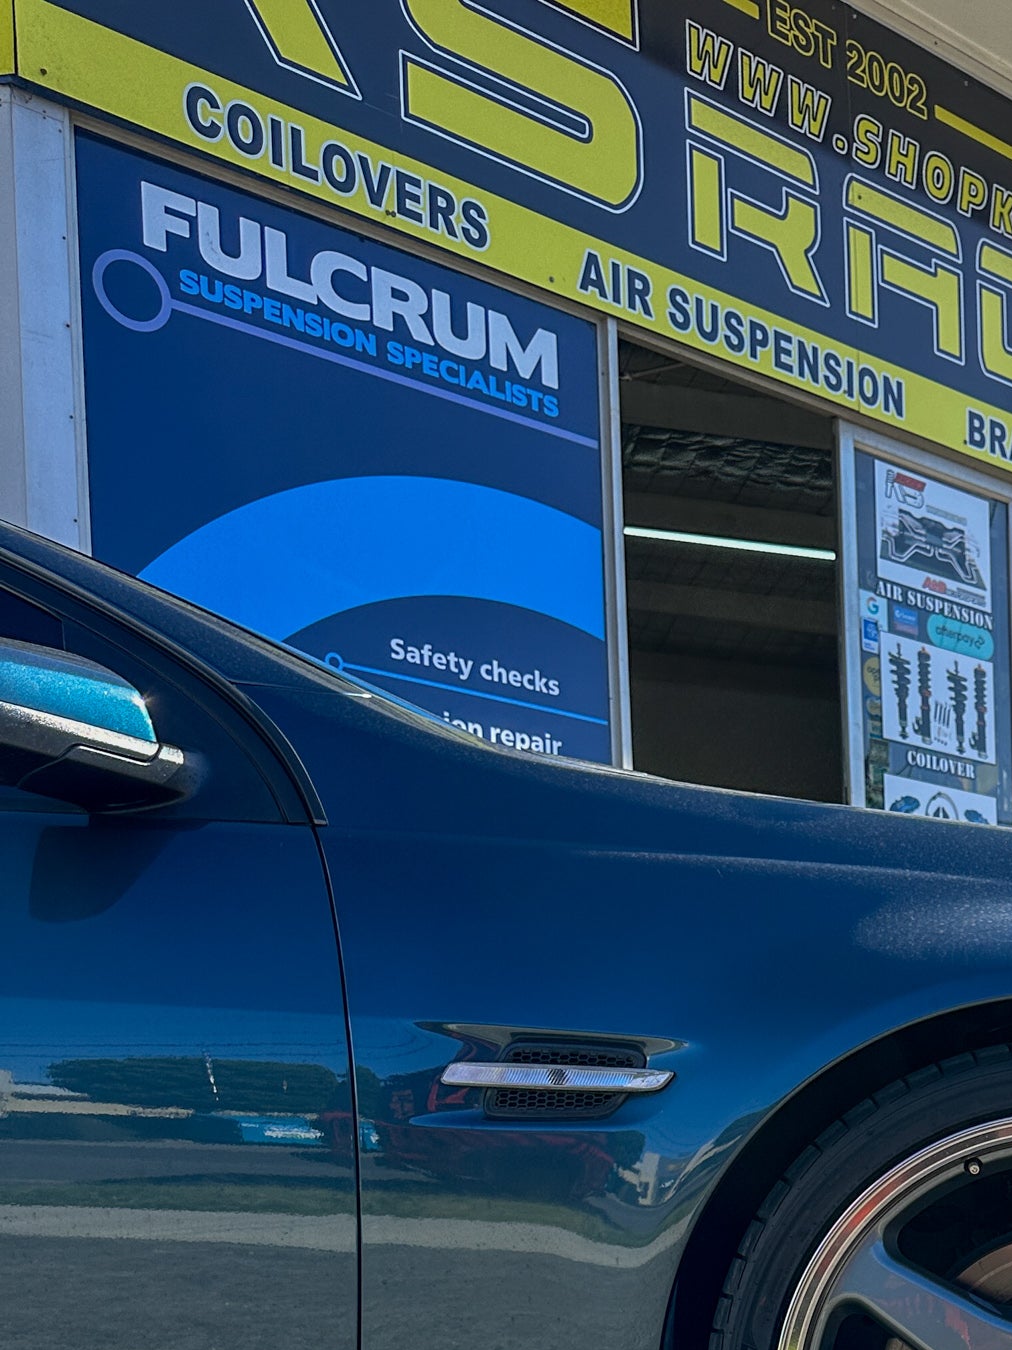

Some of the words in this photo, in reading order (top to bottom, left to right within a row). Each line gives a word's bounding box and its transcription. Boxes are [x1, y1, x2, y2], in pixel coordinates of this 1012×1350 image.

[767, 0, 837, 68] EST
[846, 39, 928, 120] 2002
[183, 83, 490, 251] COILOVERS
[140, 180, 559, 389] FULCRUM
[179, 269, 377, 356] SUSPENSION
[387, 341, 560, 418] SPECIALISTS
[578, 249, 653, 321] AIR
[666, 284, 906, 420] SUSPENSION
[876, 581, 903, 603] AIR
[907, 591, 994, 630] SUSPENSION
[390, 638, 473, 681] Safety
[479, 660, 560, 697] checks
[490, 726, 562, 755] repair
[906, 750, 976, 780] COILOVER
